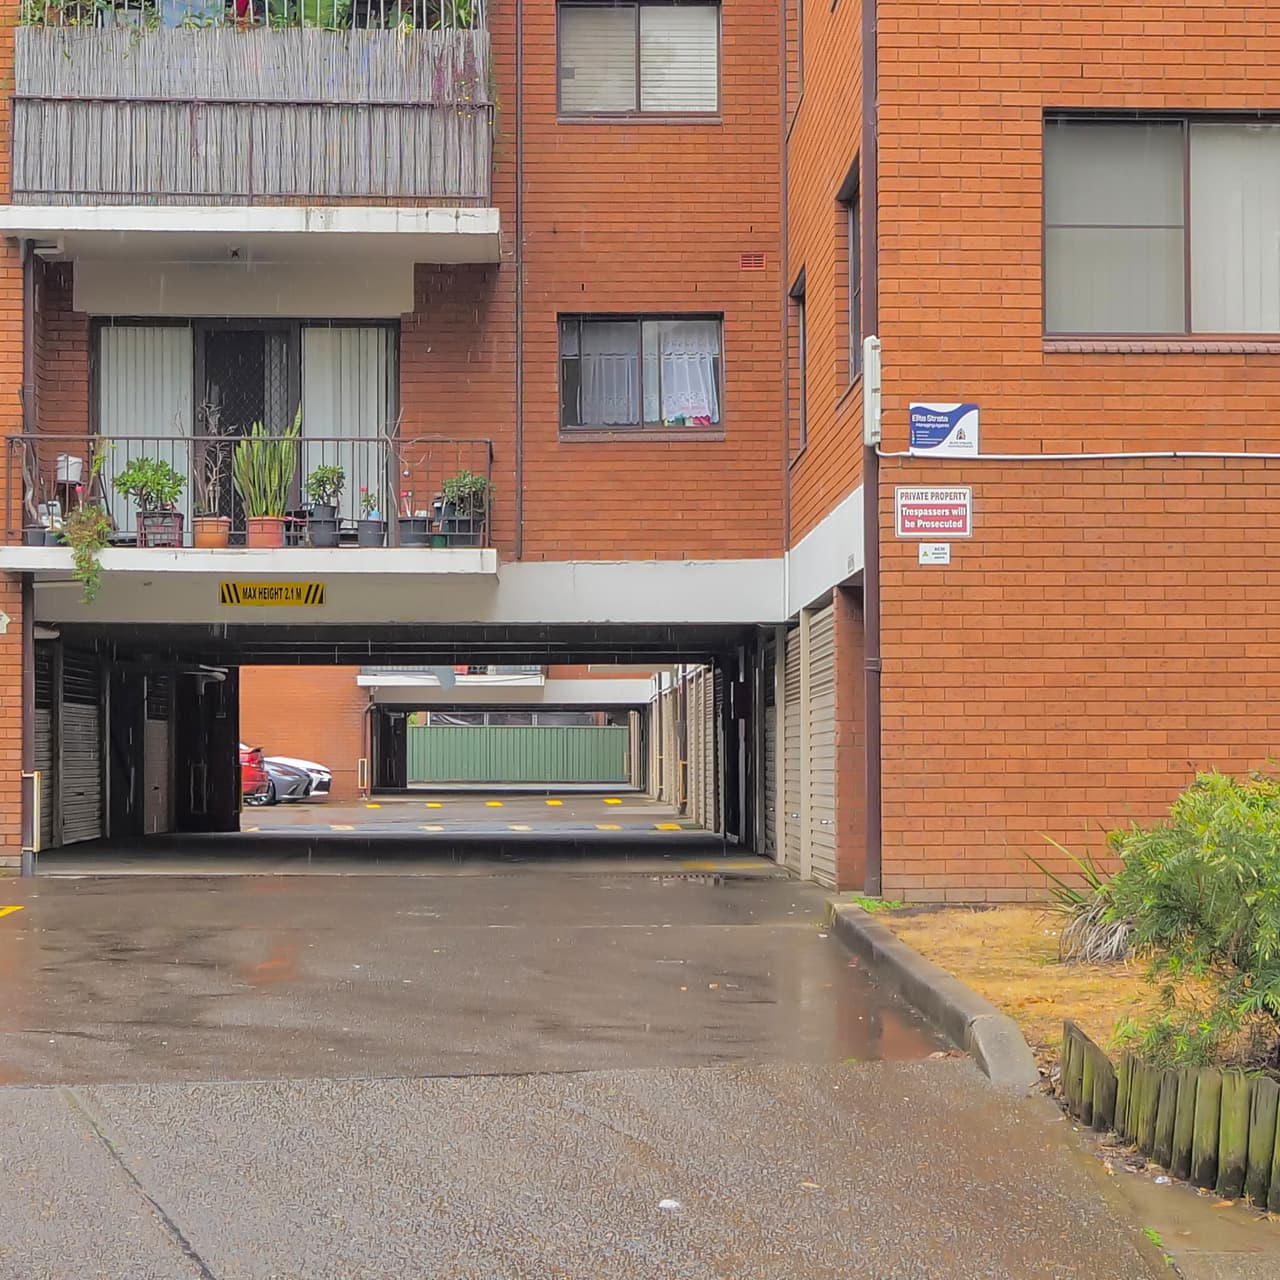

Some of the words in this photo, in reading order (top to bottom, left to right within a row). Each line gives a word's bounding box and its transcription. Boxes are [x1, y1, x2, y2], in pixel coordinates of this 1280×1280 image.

[911, 414, 926, 422] Elite
[927, 414, 949, 423] Strata
[900, 492, 929, 500] PRIVATE
[930, 492, 967, 500] PROPERTY
[901, 507, 950, 517] Trespassers
[951, 507, 966, 516] will
[904, 519, 916, 528] be
[917, 519, 963, 528] Prosecuted
[242, 587, 257, 600] MAX
[258, 587, 283, 600] HEIGHT
[284, 587, 294, 600] 2.1
[295, 587, 302, 600] M
